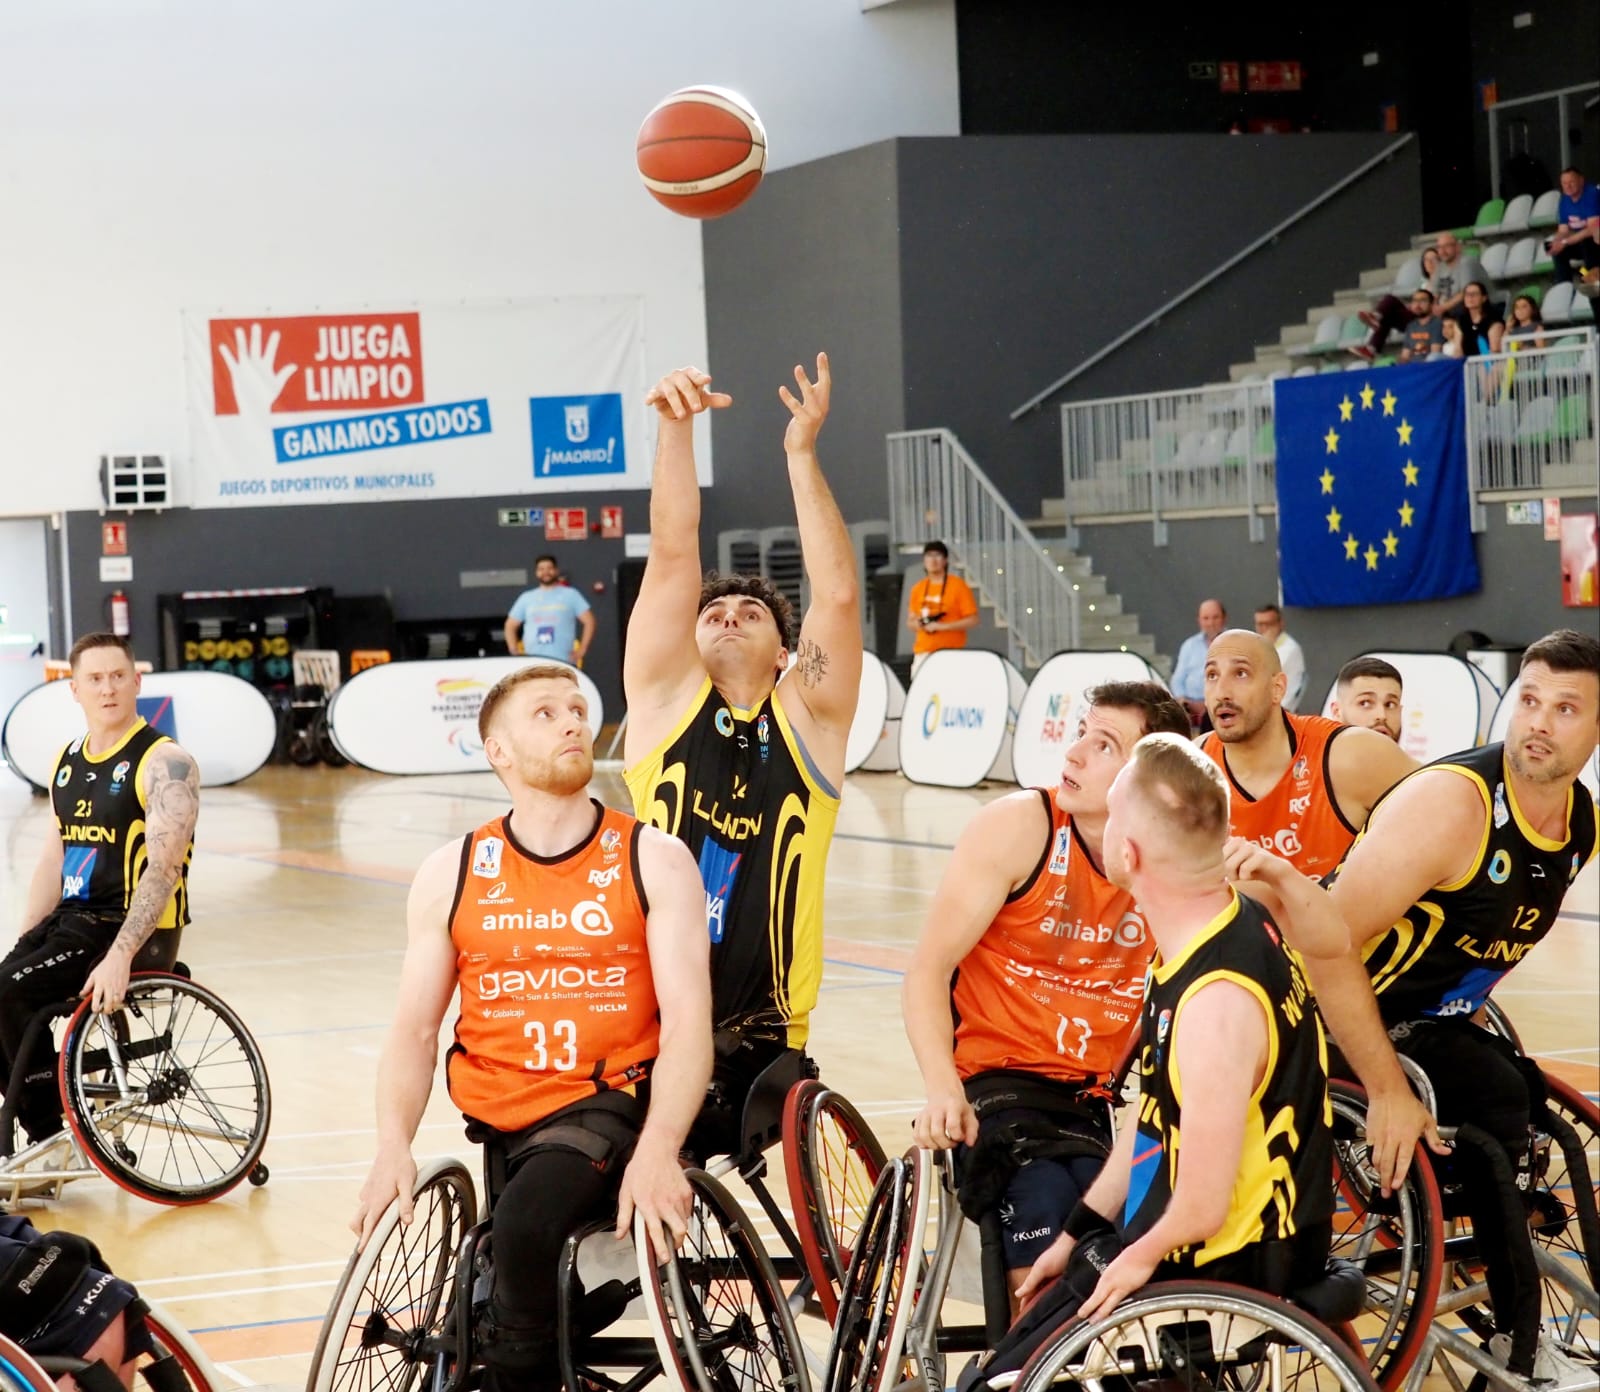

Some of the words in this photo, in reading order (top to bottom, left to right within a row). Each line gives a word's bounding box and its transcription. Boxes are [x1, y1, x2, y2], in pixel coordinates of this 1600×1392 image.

[314, 324, 411, 361] JUEGA
[304, 364, 413, 401] LIMPIO
[282, 417, 400, 458] GANAMOS
[405, 405, 482, 440] TODOS
[542, 437, 616, 474] ¡MADRID!
[219, 479, 266, 496] JUEGOS
[271, 475, 349, 493] DEPORTIVOS
[354, 472, 435, 489] MUNICIPALES
[482, 908, 567, 931] amiab
[1512, 905, 1541, 931] 12
[479, 966, 628, 1000] gaviota
[543, 992, 551, 1000] &
[552, 991, 582, 999] Shutter
[584, 990, 626, 1000] Specialists
[493, 1009, 525, 1019] Globalcaja
[595, 1004, 628, 1012] UCLM
[1109, 1012, 1130, 1022] UCL
[523, 1019, 577, 1072] 33
[1056, 1012, 1093, 1060] 13
